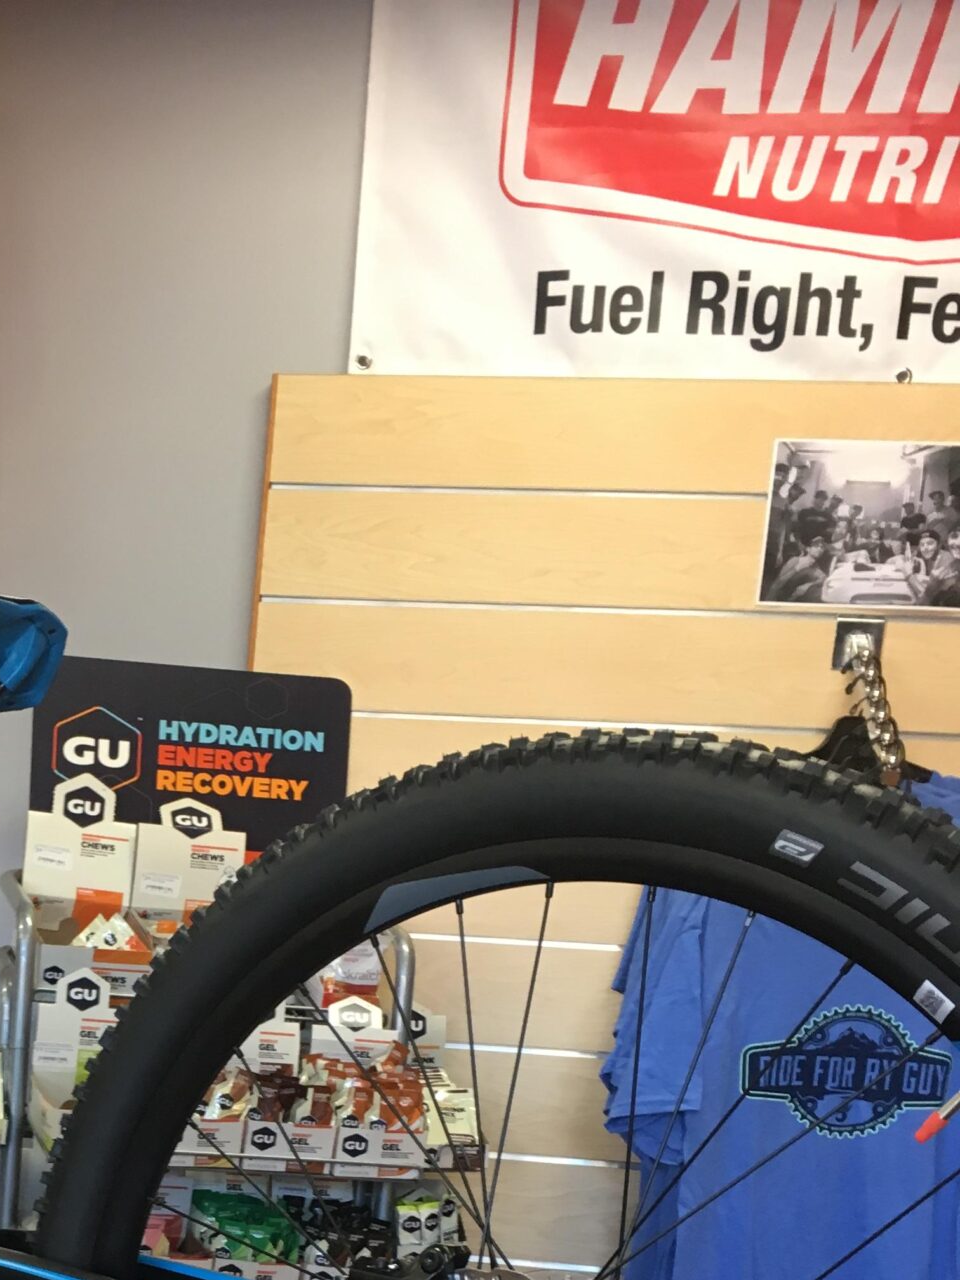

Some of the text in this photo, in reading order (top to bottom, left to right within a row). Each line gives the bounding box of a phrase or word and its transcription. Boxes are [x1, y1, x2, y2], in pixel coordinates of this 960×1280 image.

[533, 269, 665, 335] Fuel
[685, 270, 874, 352] Right,
[158, 719, 324, 752] HYDRATION
[62, 735, 131, 769] GU
[157, 745, 273, 773] ENERGY
[156, 770, 310, 801] RECOVERY
[67, 799, 101, 817] GU
[175, 815, 209, 828] GU
[81, 841, 116, 852] CHEWS
[190, 852, 225, 863] CHEWS
[69, 987, 97, 1002] GU
[340, 1011, 369, 1024] GU
[80, 1030, 99, 1040] GEL
[258, 1043, 277, 1052] GEL
[353, 1050, 372, 1059] GEL
[758, 1055, 808, 1088] RIDE
[813, 1055, 856, 1090] FOR
[902, 1061, 948, 1097] GUY
[253, 1134, 274, 1144] GU
[290, 1137, 310, 1146] GEL
[344, 1140, 366, 1151] GU
[382, 1143, 402, 1152] GEL
[403, 1221, 421, 1229] GU
